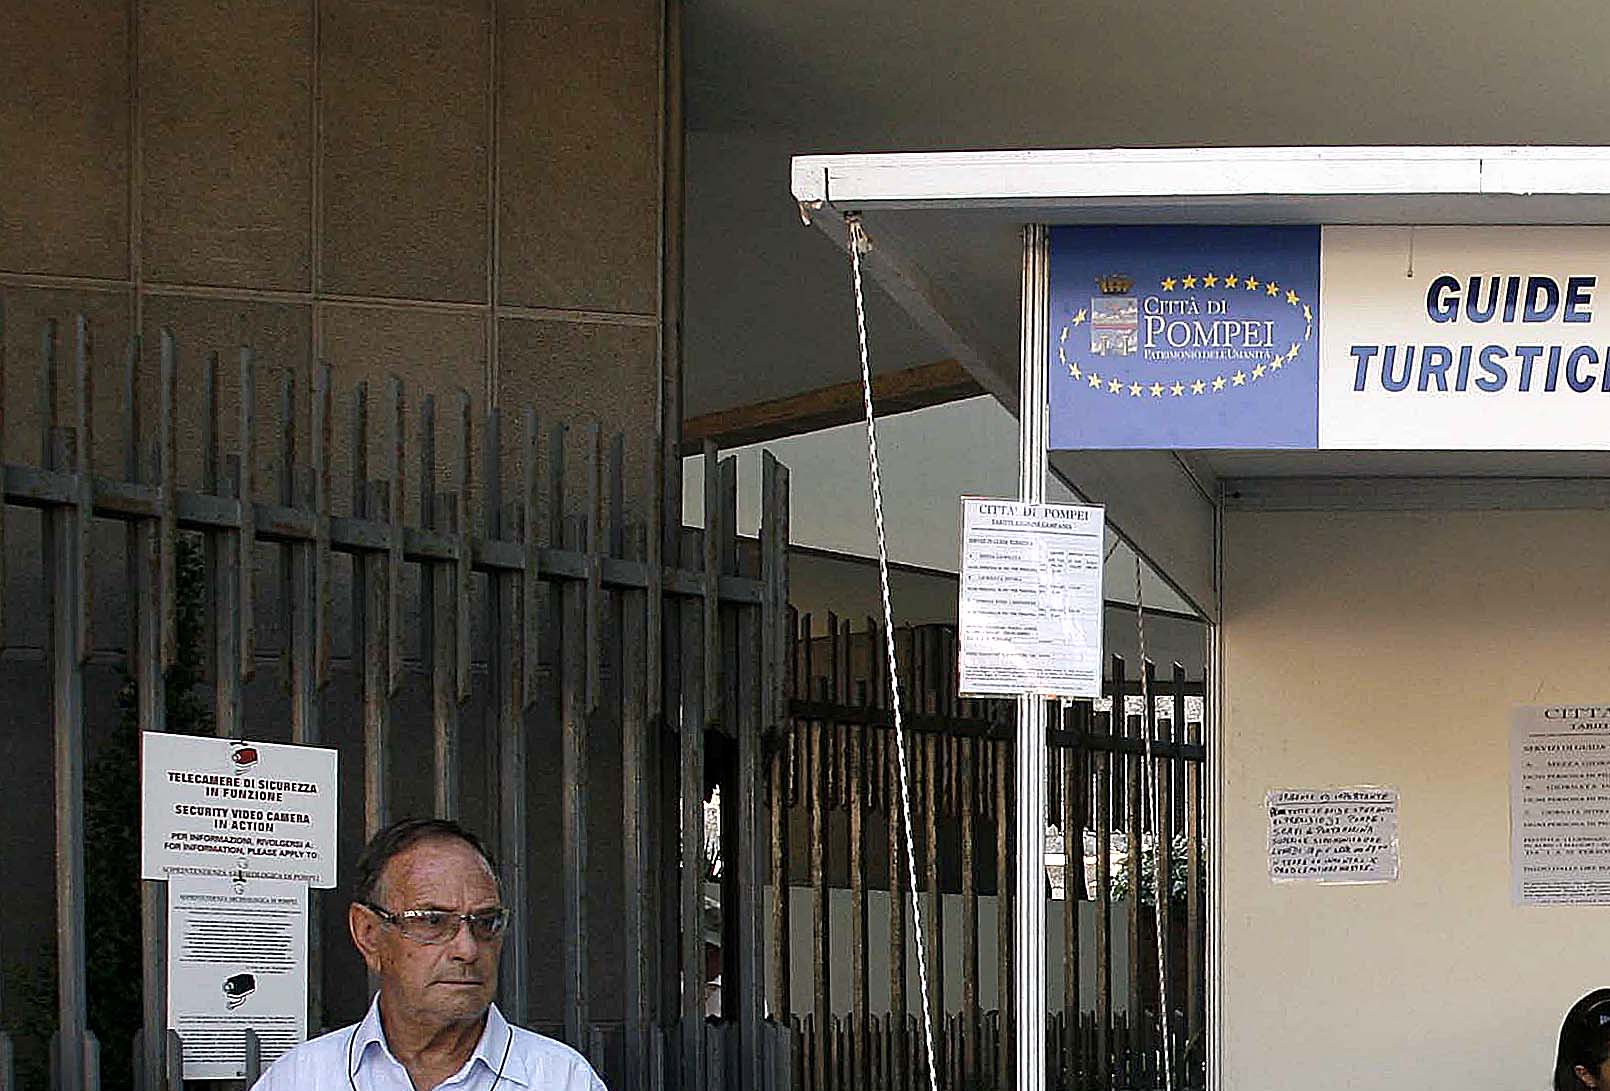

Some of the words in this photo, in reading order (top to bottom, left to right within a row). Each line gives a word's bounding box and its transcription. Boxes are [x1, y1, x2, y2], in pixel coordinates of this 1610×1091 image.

[1425, 275, 1598, 324] GUIDE
[1143, 315, 1275, 348] POMPEI
[1043, 507, 1090, 521] POMPEI
[167, 771, 241, 788] TELECAMERE
[243, 778, 256, 788] DI
[258, 779, 318, 794] SICUREZZA
[205, 787, 219, 797] IN
[223, 788, 284, 802] FUNZIONE
[175, 804, 229, 817] SECURITY
[231, 809, 264, 821] VIDEO
[266, 811, 311, 823] CAMERA
[214, 819, 228, 829] IN
[231, 821, 275, 832] ACTION
[171, 833, 188, 842] PER
[164, 843, 181, 851] FOR
[279, 850, 304, 859] APPLY
